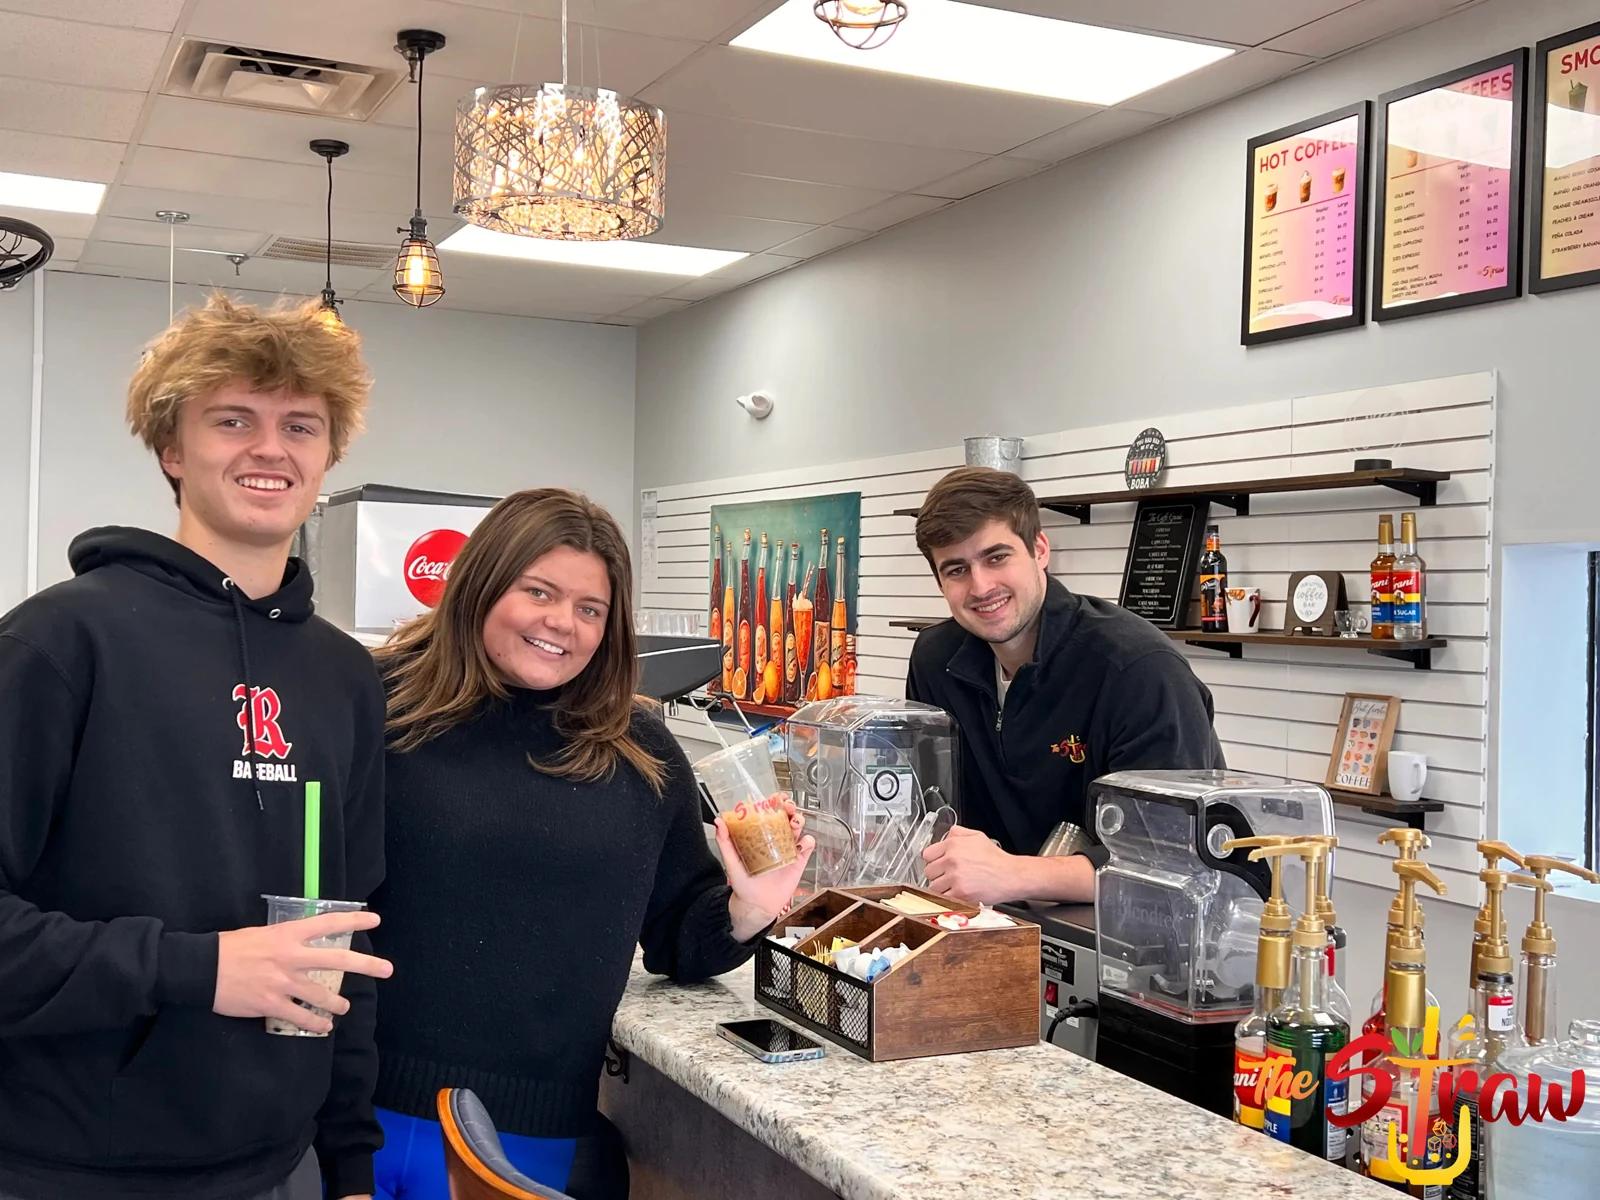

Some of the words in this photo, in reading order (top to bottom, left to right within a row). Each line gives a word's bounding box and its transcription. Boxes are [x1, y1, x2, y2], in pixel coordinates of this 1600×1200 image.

[1260, 150, 1289, 173] HOT
[1553, 188, 1570, 196] MANGO
[1553, 202, 1571, 210] ORANGE
[1552, 217, 1572, 225] PEACHES
[1578, 212, 1594, 220] CREAM
[1564, 229, 1583, 237] COLADA
[1551, 244, 1581, 254] STRAWBERRY
[1130, 477, 1150, 490] BOBA
[1371, 576, 1390, 589] rani
[1393, 575, 1415, 590] rani
[1296, 587, 1324, 601] coffee
[1353, 702, 1366, 714] But
[232, 683, 292, 760] R
[1334, 774, 1371, 788] COFFEE
